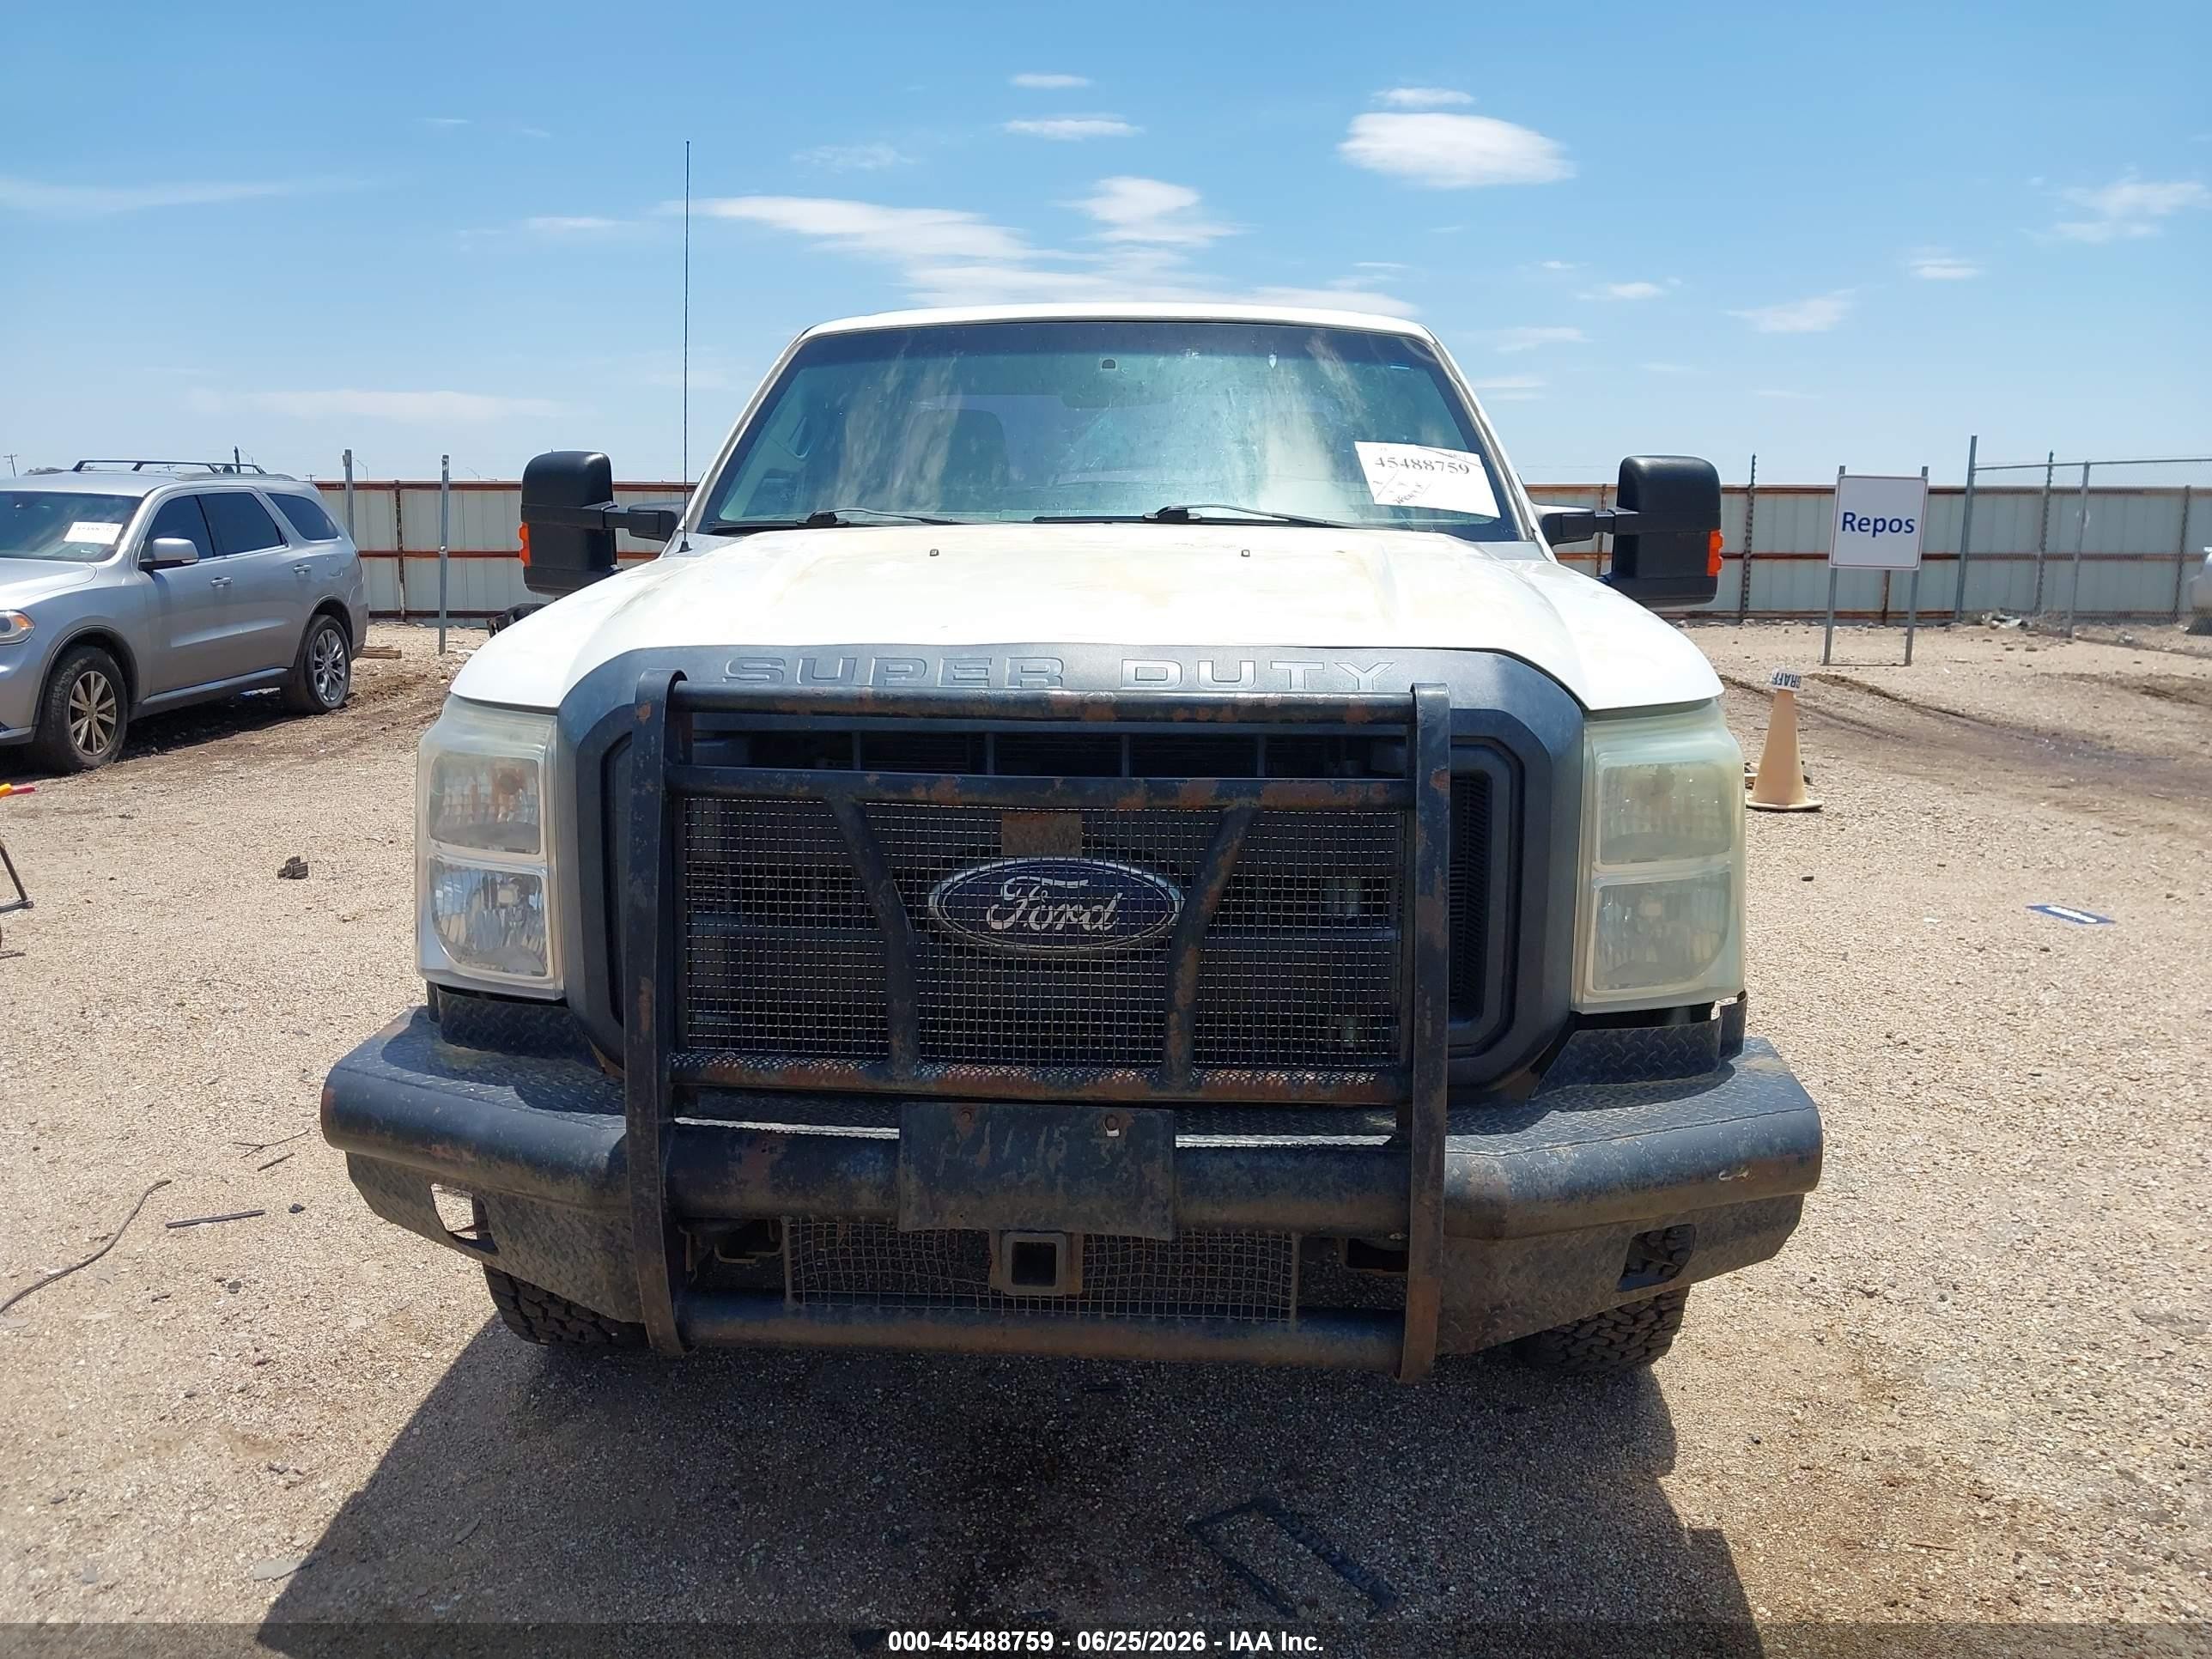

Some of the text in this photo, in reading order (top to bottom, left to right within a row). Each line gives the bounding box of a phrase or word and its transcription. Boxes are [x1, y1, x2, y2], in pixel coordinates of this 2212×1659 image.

[1374, 456, 1470, 475] 45488759
[1841, 511, 1916, 538] Repos
[722, 656, 1395, 691] SUPER DUTY
[985, 875, 1123, 932] Ford
